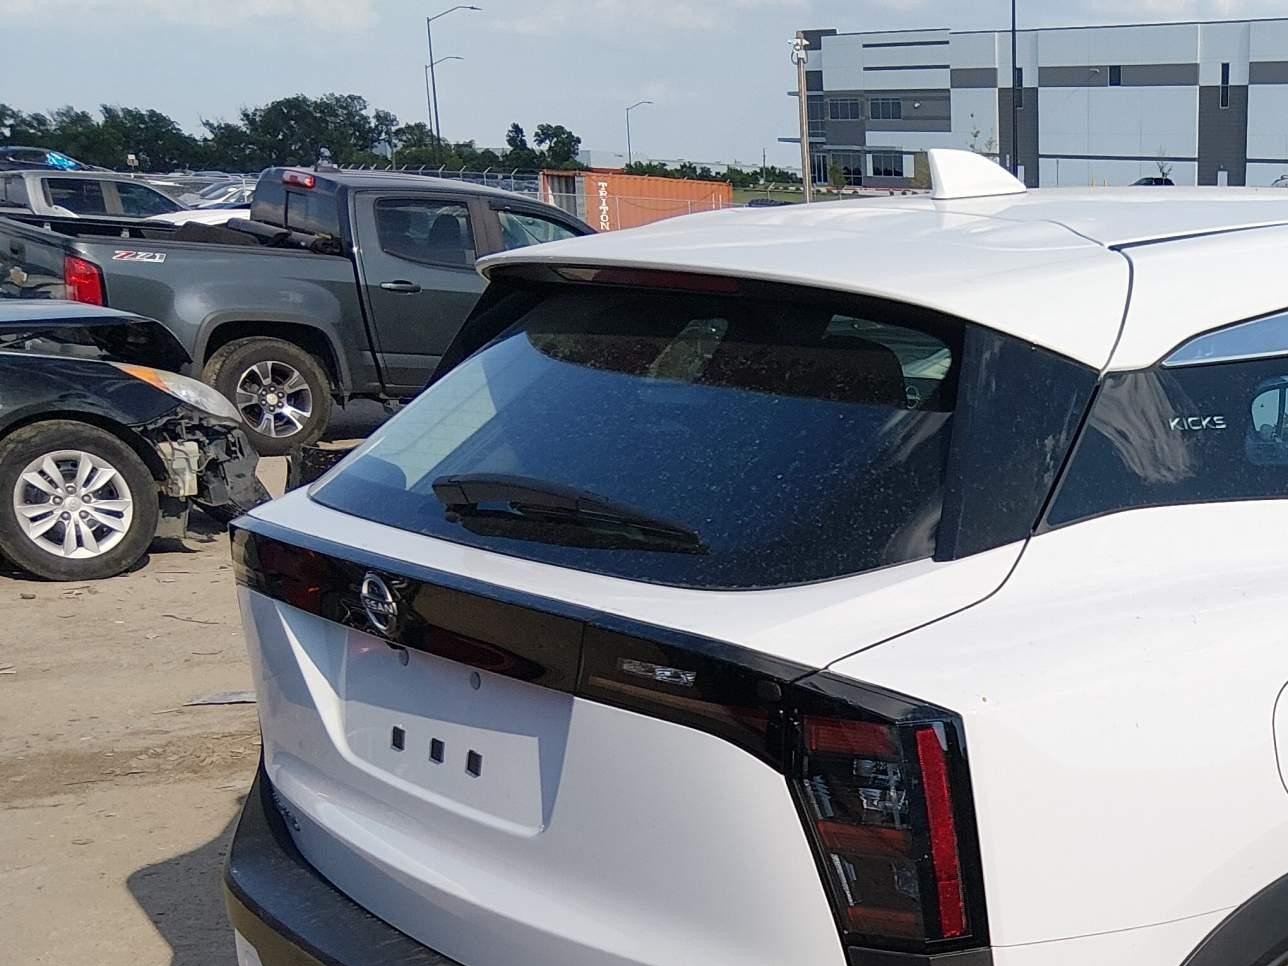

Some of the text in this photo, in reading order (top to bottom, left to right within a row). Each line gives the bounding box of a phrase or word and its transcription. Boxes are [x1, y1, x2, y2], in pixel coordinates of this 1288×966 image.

[598, 182, 610, 231] TRITON
[111, 250, 167, 263] Z71
[1168, 416, 1227, 431] KICKS
